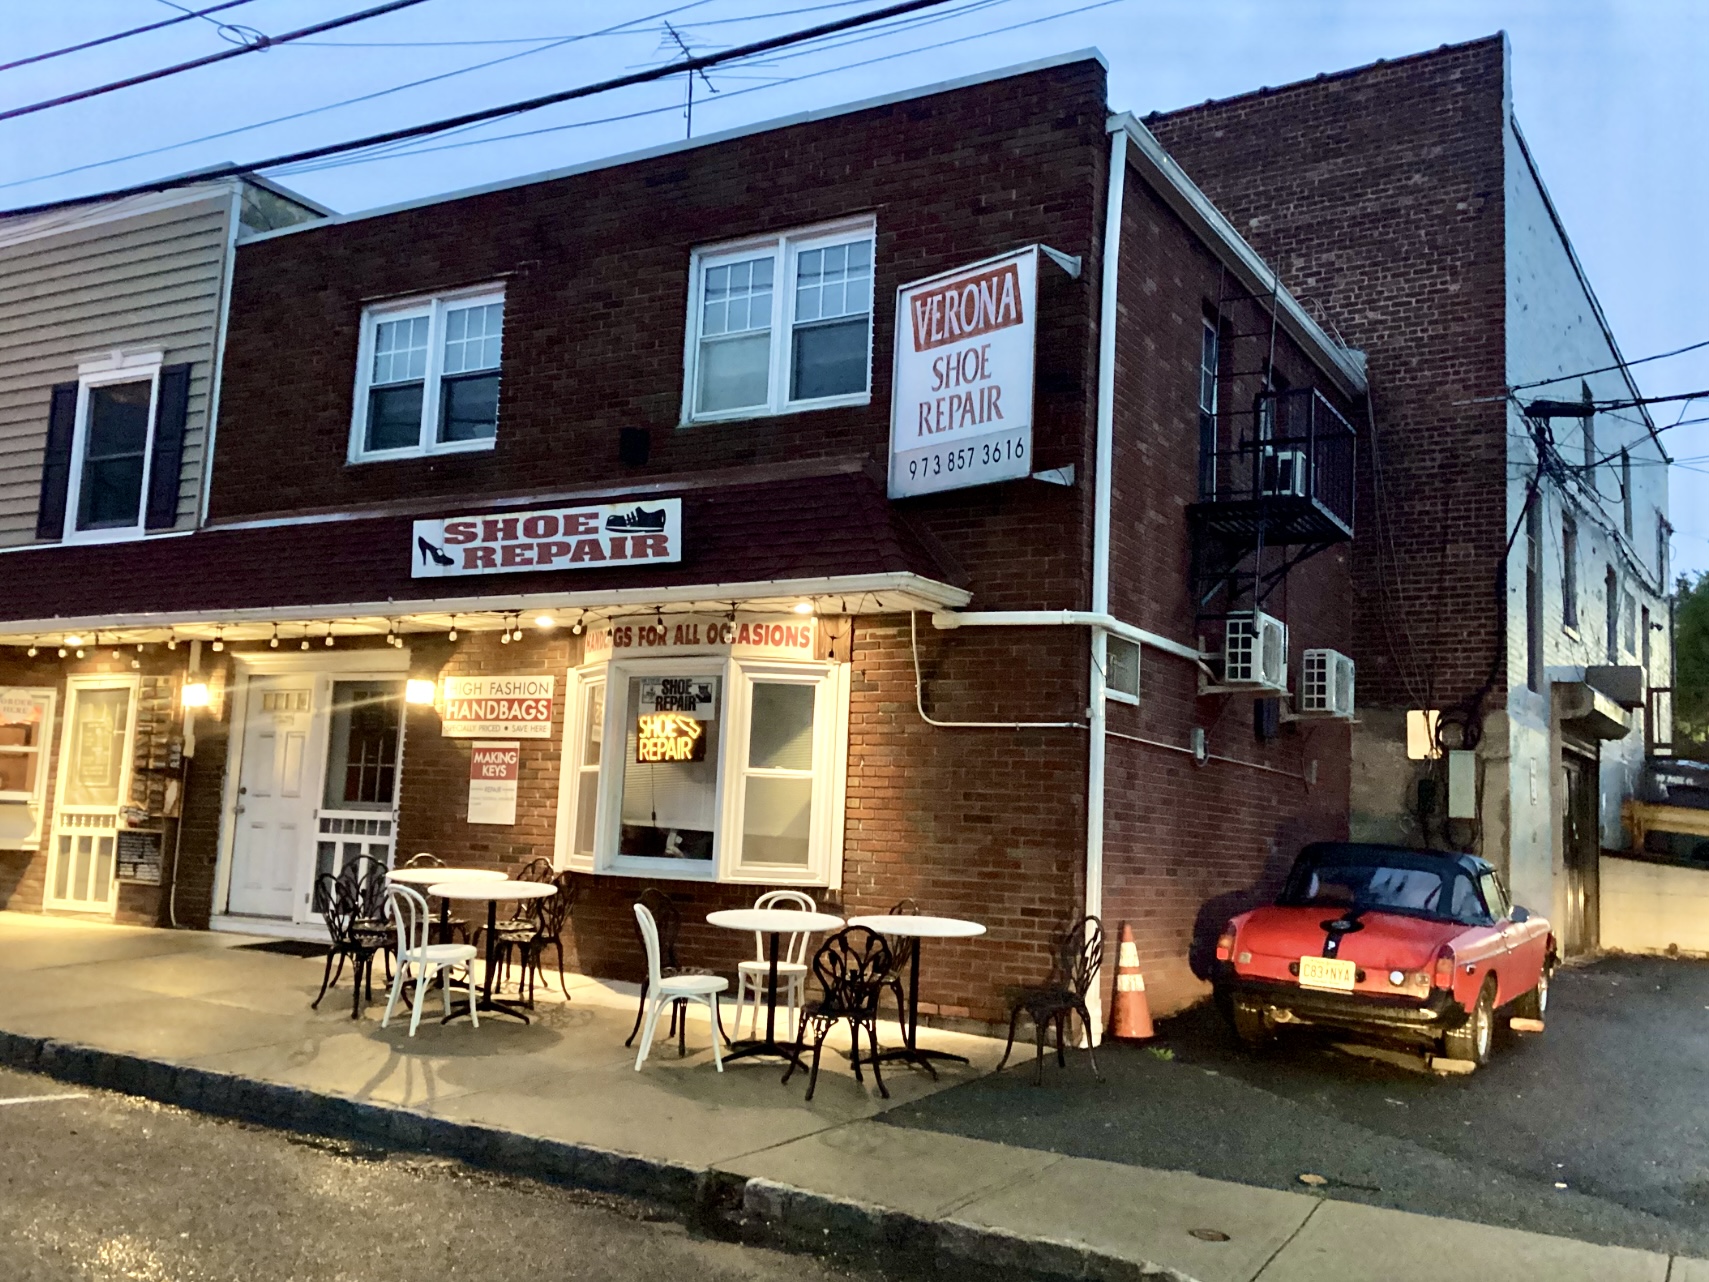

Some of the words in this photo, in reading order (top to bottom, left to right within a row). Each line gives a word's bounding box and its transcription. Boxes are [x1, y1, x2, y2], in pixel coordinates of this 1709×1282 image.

[915, 272, 1017, 345] VERONA
[931, 343, 992, 392] SHOE
[918, 384, 1004, 437] REPAIR
[909, 454, 941, 480] 973
[947, 447, 974, 472] 857
[982, 437, 1024, 465] 3616
[444, 512, 599, 545] SHOE
[462, 533, 670, 570] REPAIR
[637, 625, 667, 647] FOR
[673, 623, 700, 646] ALL
[490, 681, 549, 696] FASHION
[661, 678, 693, 695] SHOE
[446, 699, 548, 720] HANDBAGS
[655, 695, 696, 712] REPAIR
[478, 724, 501, 733] PRICED
[511, 724, 528, 733] SAVE
[530, 724, 547, 733] HERE
[639, 713, 678, 738] SHOE
[474, 751, 517, 765] MAKING
[639, 736, 692, 761] REPAIR
[482, 764, 507, 777] KEYS
[1330, 967, 1350, 982] NYA
